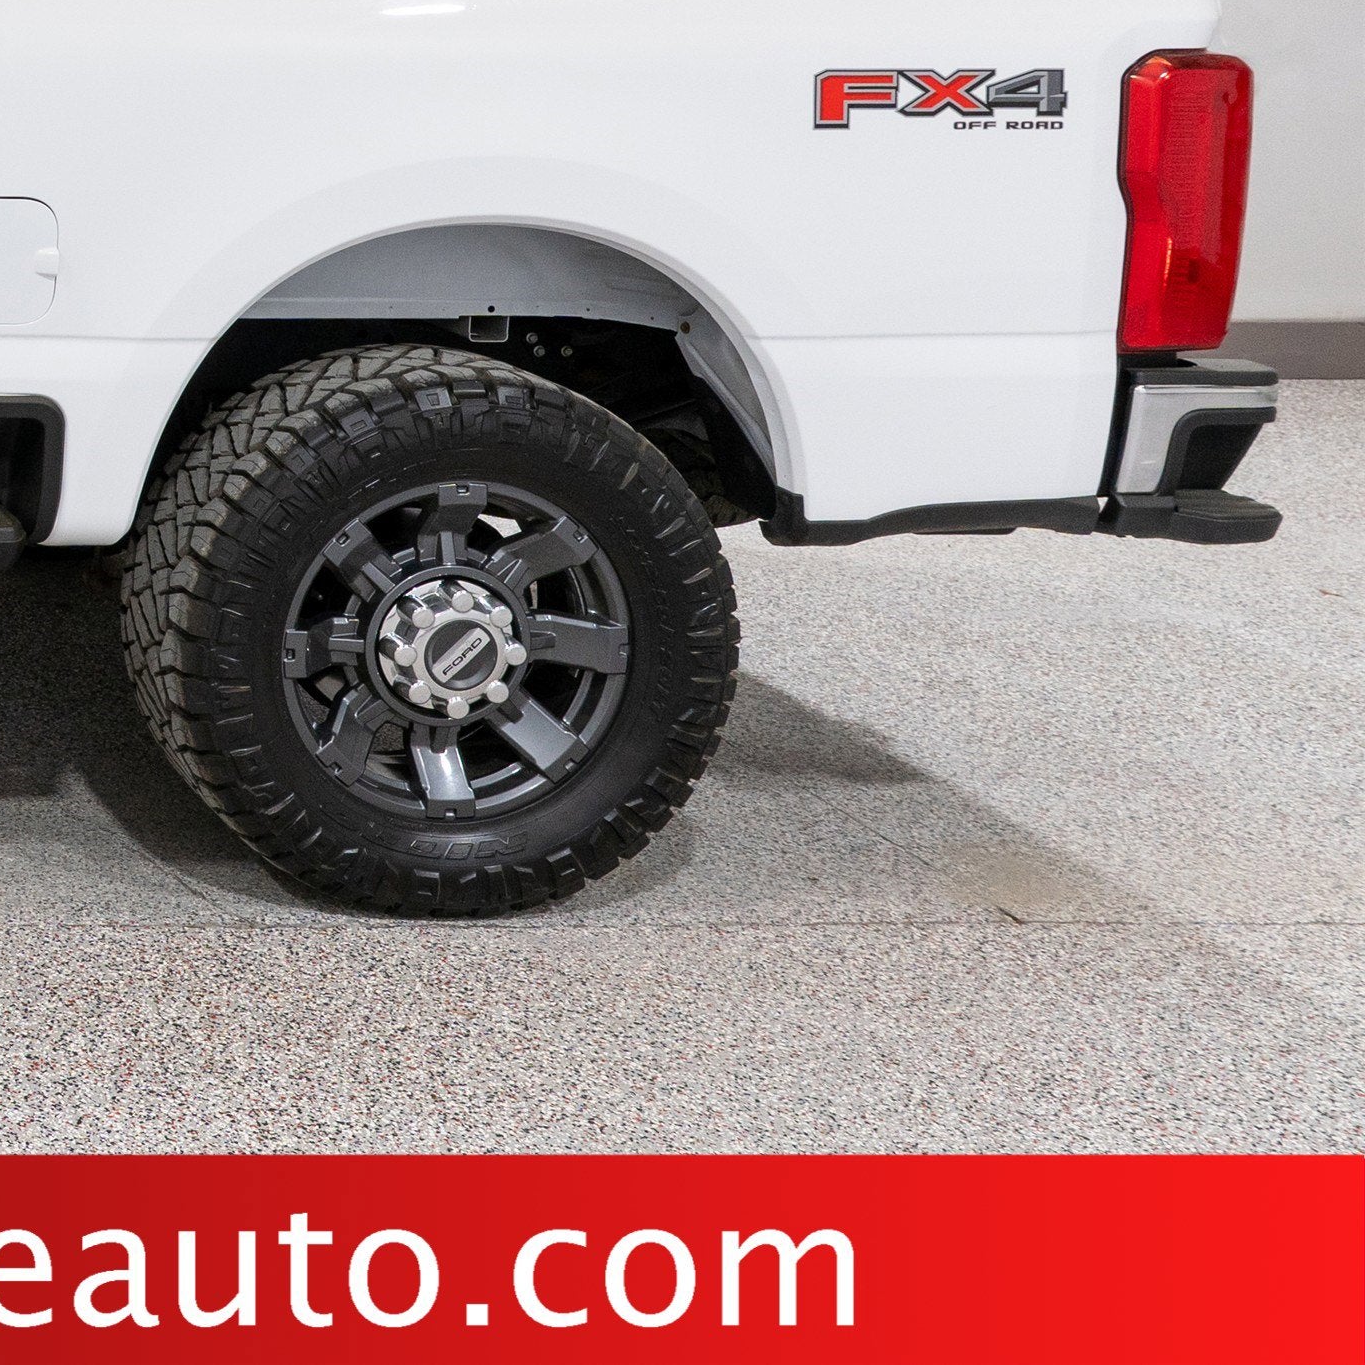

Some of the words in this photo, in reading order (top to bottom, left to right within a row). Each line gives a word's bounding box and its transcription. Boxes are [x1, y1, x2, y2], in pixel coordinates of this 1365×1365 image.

[815, 69, 1067, 129] FX4
[953, 121, 996, 130] OFF
[1006, 121, 1063, 130] ROAD
[442, 637, 483, 677] FORD
